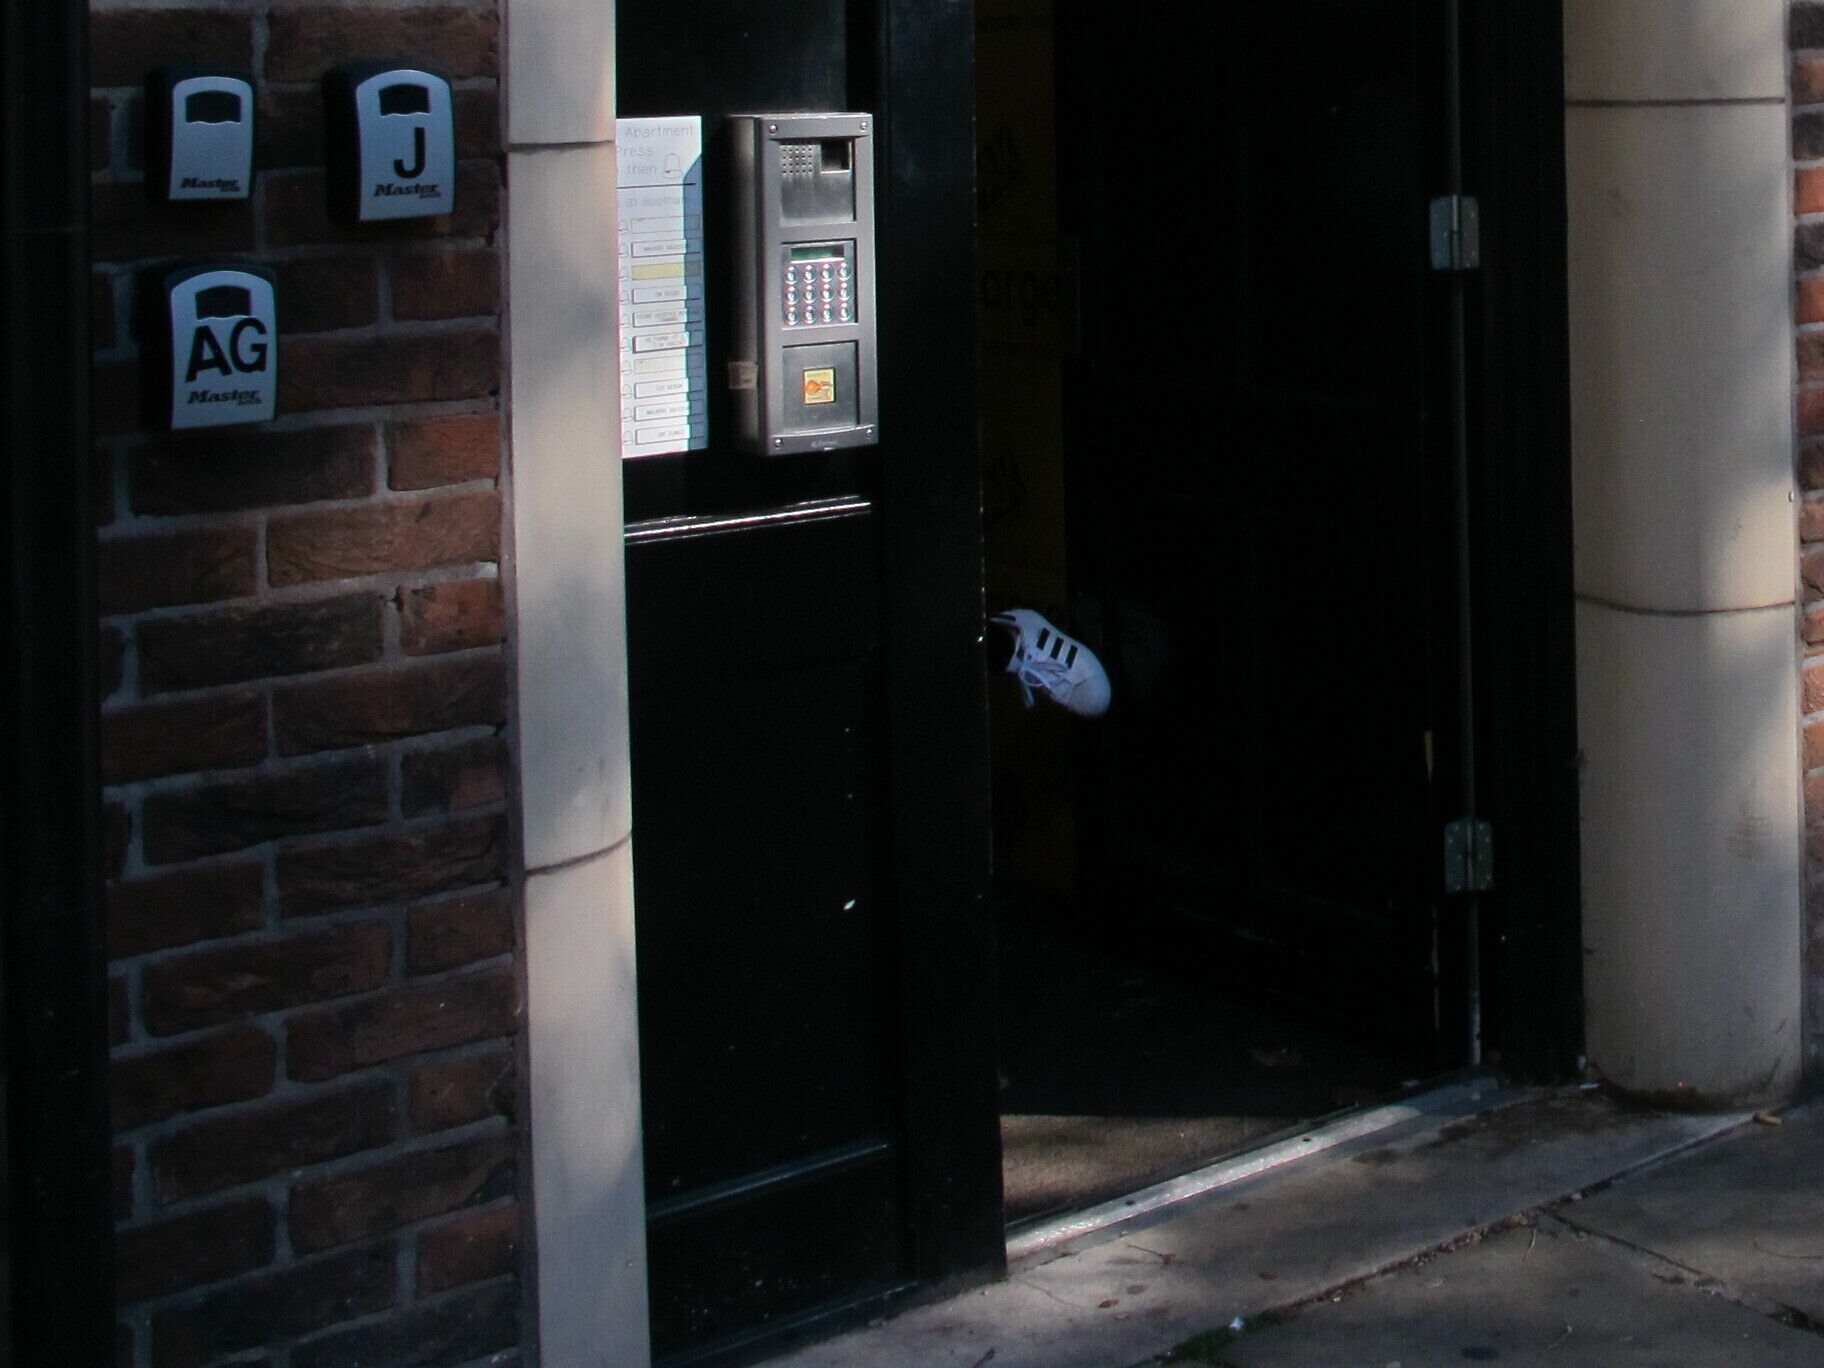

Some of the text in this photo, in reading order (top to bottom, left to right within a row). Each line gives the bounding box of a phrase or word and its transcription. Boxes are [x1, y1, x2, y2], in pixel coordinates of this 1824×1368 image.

[393, 126, 427, 180] J
[625, 125, 694, 139] Apartment
[184, 316, 269, 383] AG
